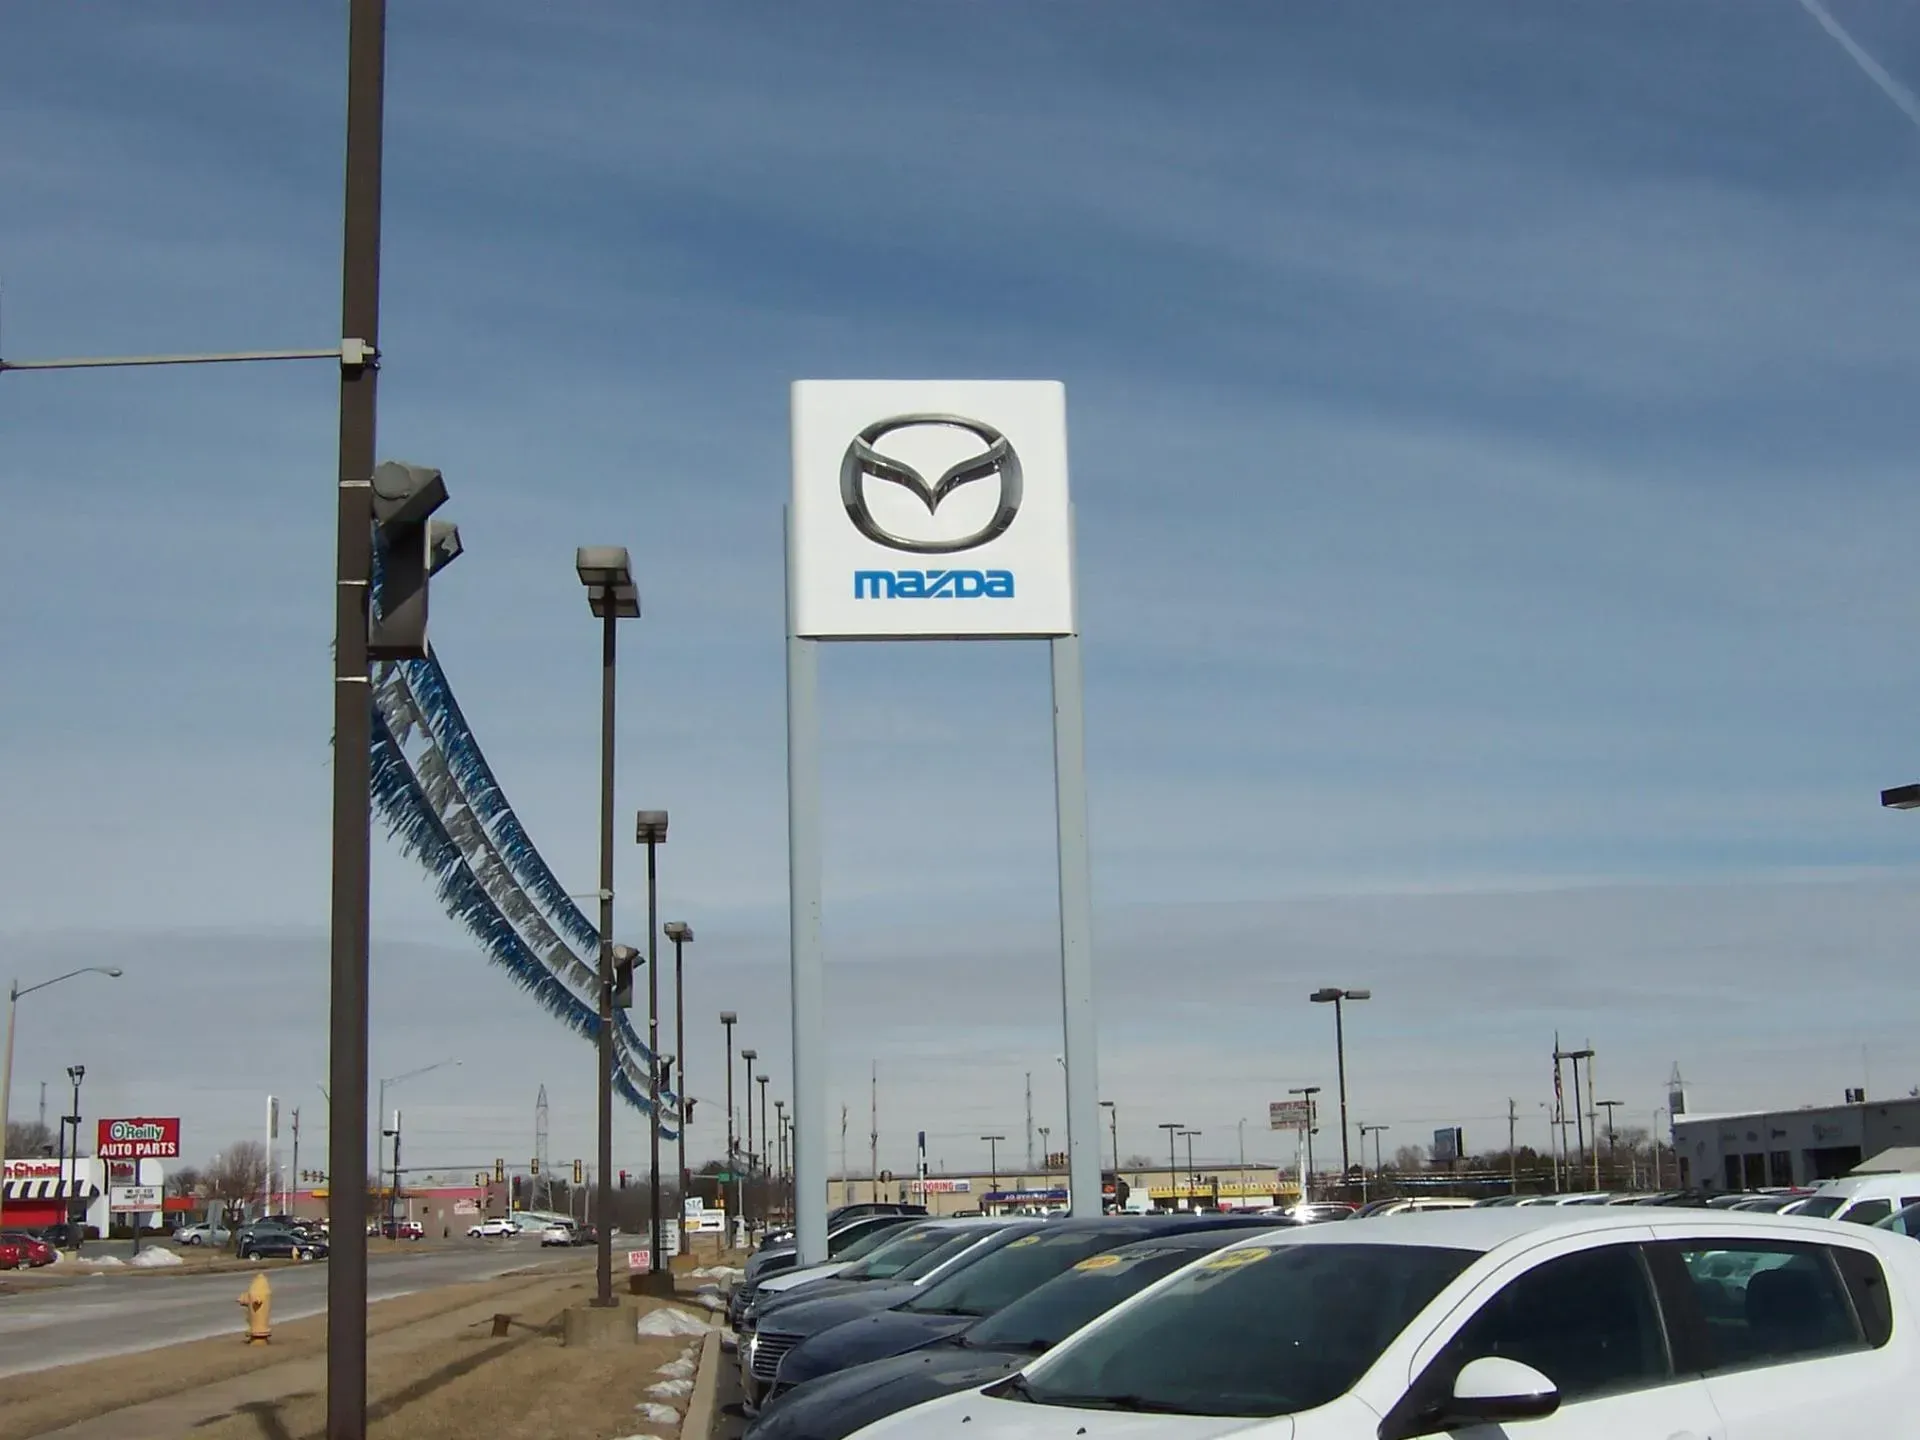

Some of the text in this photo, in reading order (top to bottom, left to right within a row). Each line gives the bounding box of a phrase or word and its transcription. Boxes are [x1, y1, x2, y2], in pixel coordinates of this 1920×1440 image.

[855, 570, 1015, 599] mazda
[111, 1121, 164, 1141] O'Reilly
[99, 1142, 176, 1156] AUTO PARTS
